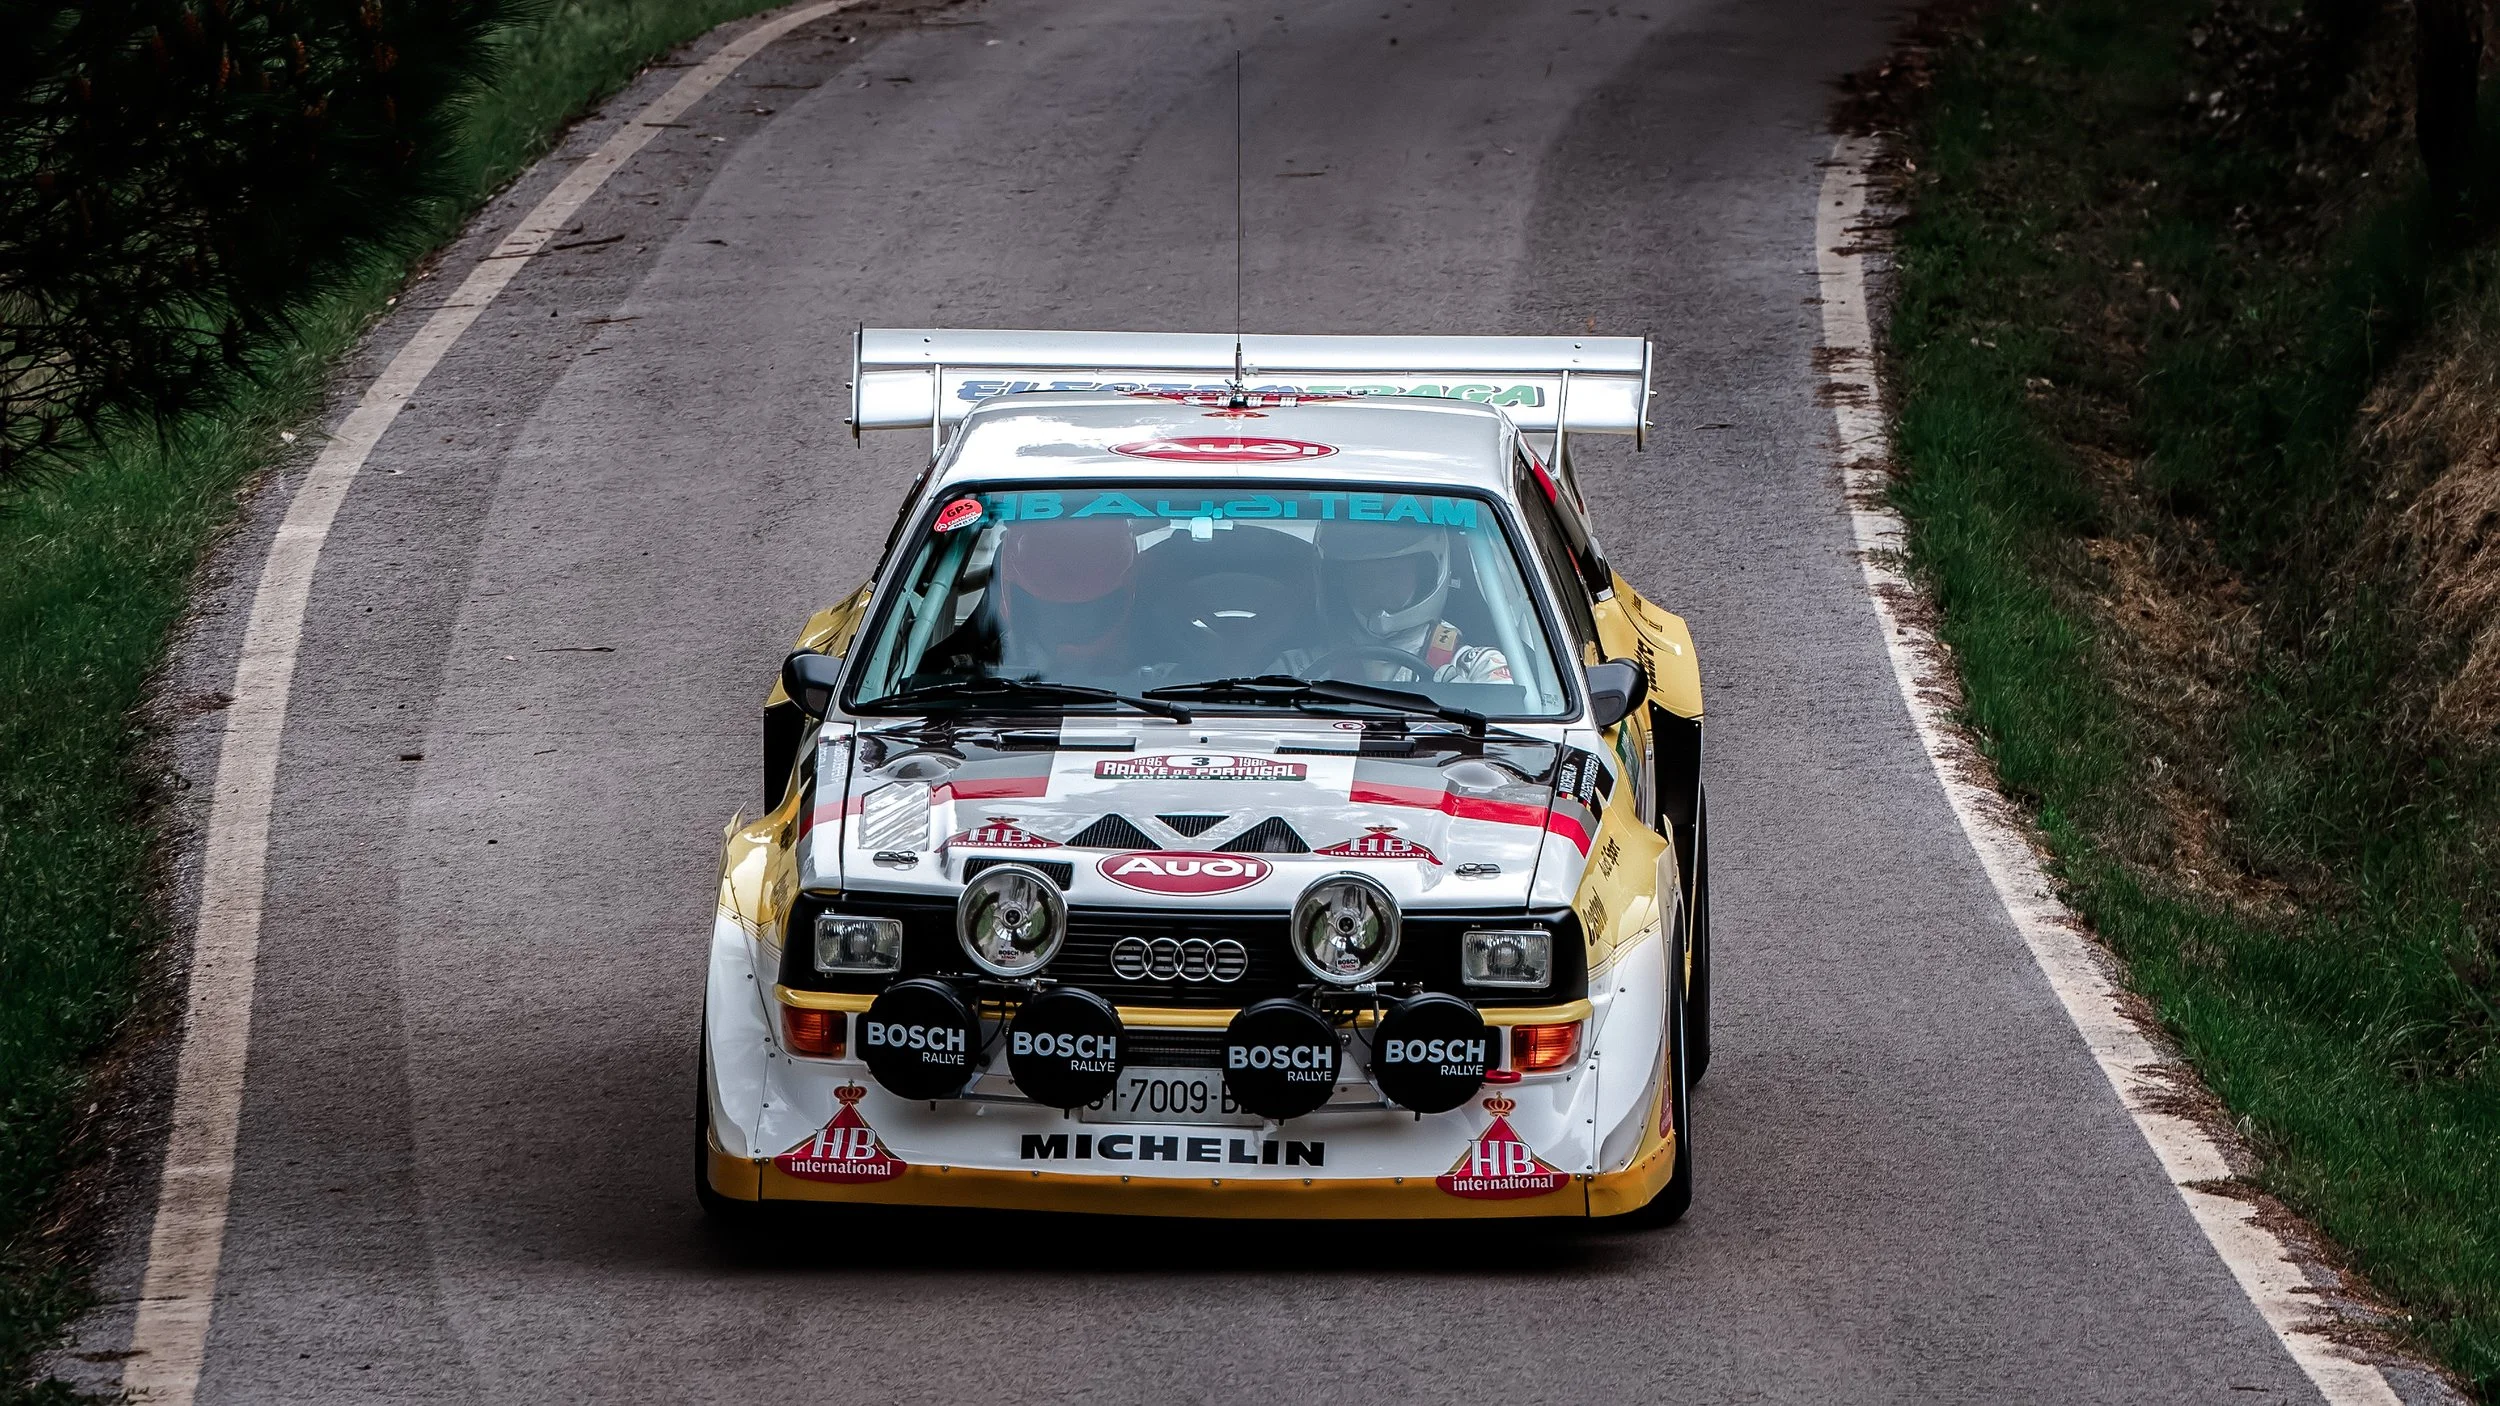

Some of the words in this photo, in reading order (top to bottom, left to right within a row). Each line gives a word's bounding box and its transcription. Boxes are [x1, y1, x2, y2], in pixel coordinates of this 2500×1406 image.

[946, 502, 974, 518] GPS
[978, 493, 1064, 521] HB
[1309, 492, 1478, 529] TEAM
[1103, 761, 1169, 776] RALLYE
[1196, 764, 1298, 778] PORTUGAL
[1134, 756, 1163, 767] 1986
[1191, 756, 1210, 767] 3
[968, 828, 1032, 843] HB
[1349, 838, 1413, 852] HB
[1329, 850, 1431, 859] international
[867, 1022, 966, 1052] BOSCH
[1013, 1031, 1117, 1059] BOSCH
[922, 1051, 966, 1066] RALLYE
[1229, 1045, 1333, 1069] BOSCH
[1385, 1039, 1486, 1063] BOSCH
[1070, 1060, 1116, 1073] RALLYE
[1440, 1065, 1484, 1076] RALLYE
[1287, 1071, 1333, 1082] RALLYE
[811, 1127, 877, 1160] HB
[1020, 1134, 1326, 1167] MICHELIN
[791, 1156, 892, 1176] international
[1470, 1139, 1536, 1177] HB
[1453, 1173, 1555, 1191] international
